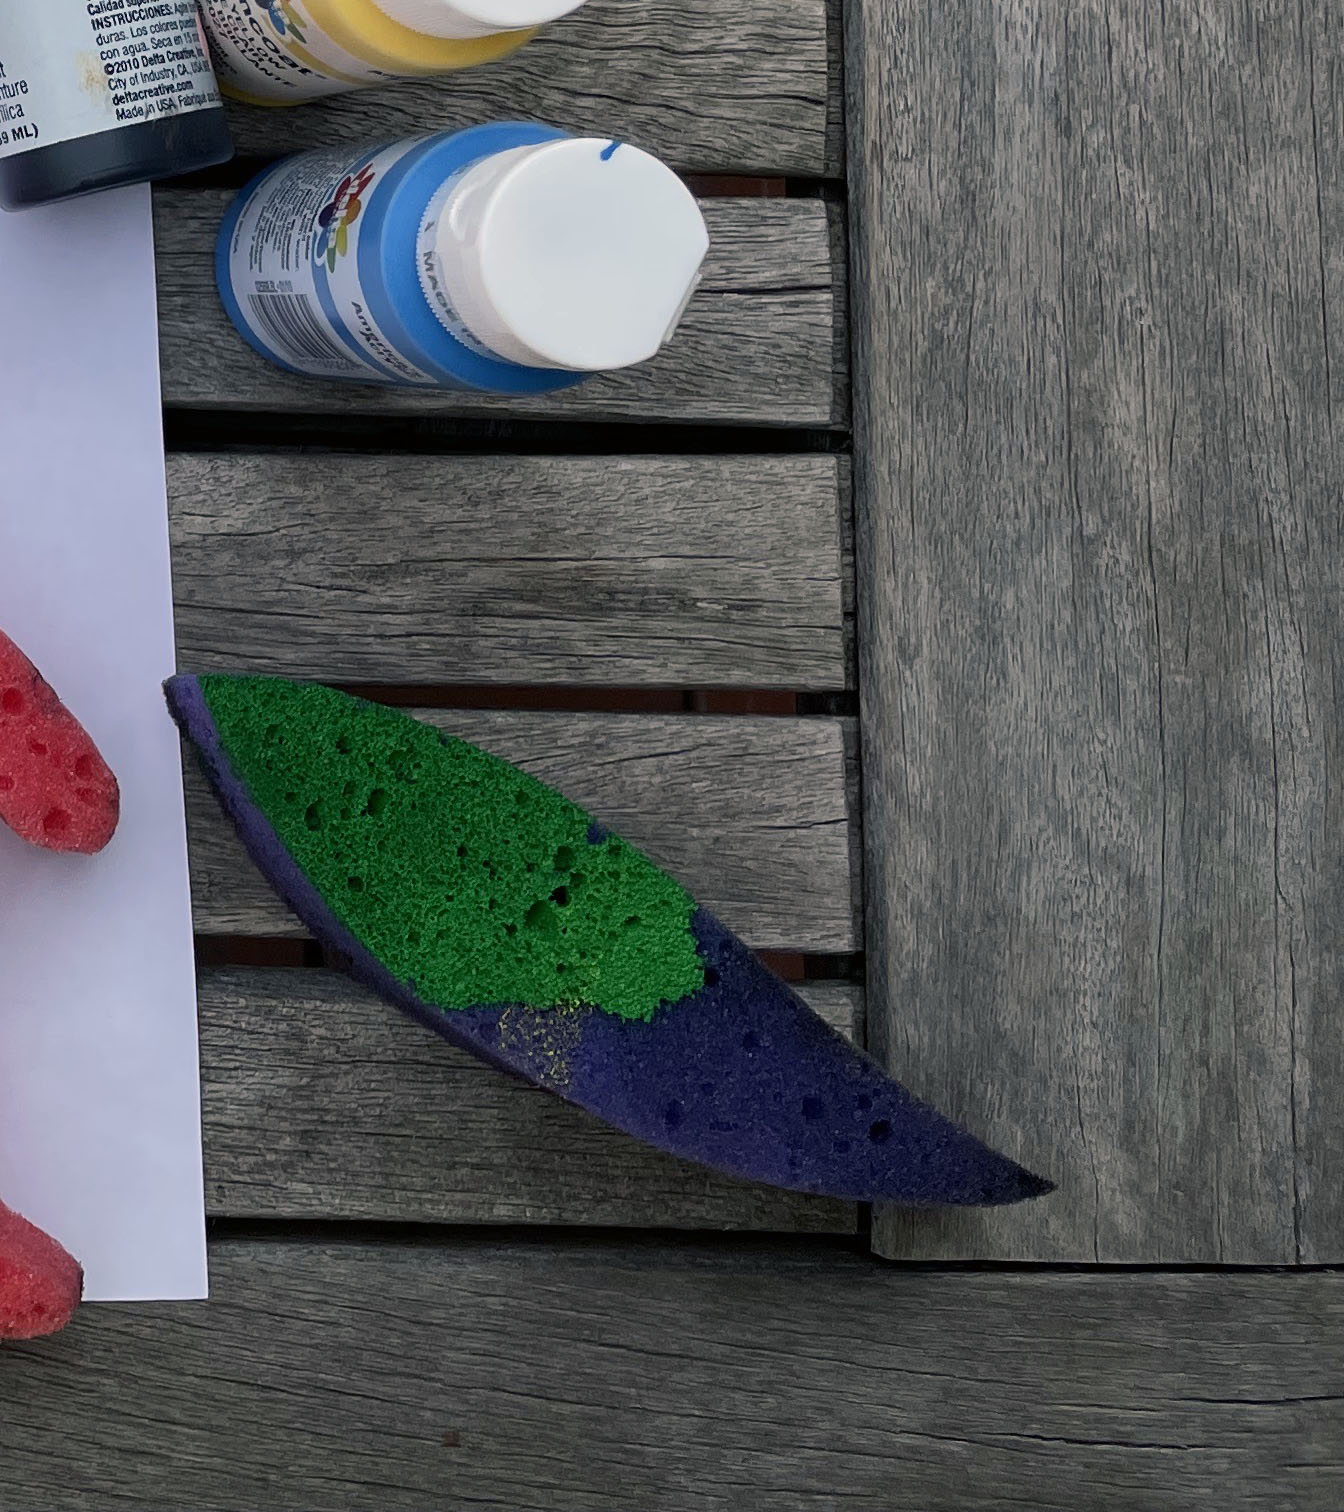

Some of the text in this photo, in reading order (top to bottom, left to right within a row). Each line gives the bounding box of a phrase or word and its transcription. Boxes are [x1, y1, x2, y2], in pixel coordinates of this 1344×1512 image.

[91, 4, 173, 31] INSTRUCCIONES:
[95, 30, 129, 46] duras.
[130, 26, 148, 38] Los
[149, 20, 178, 34] colores
[225, 14, 266, 65] CLAIR
[231, 2, 287, 71] YELLOW
[100, 48, 120, 61] con
[150, 37, 174, 50] Seca
[142, 53, 165, 67] Delta
[108, 78, 127, 90] City
[129, 74, 139, 86] of
[112, 80, 194, 106] deltacreative.com
[116, 105, 144, 121] Made
[422, 251, 462, 323] MADE
